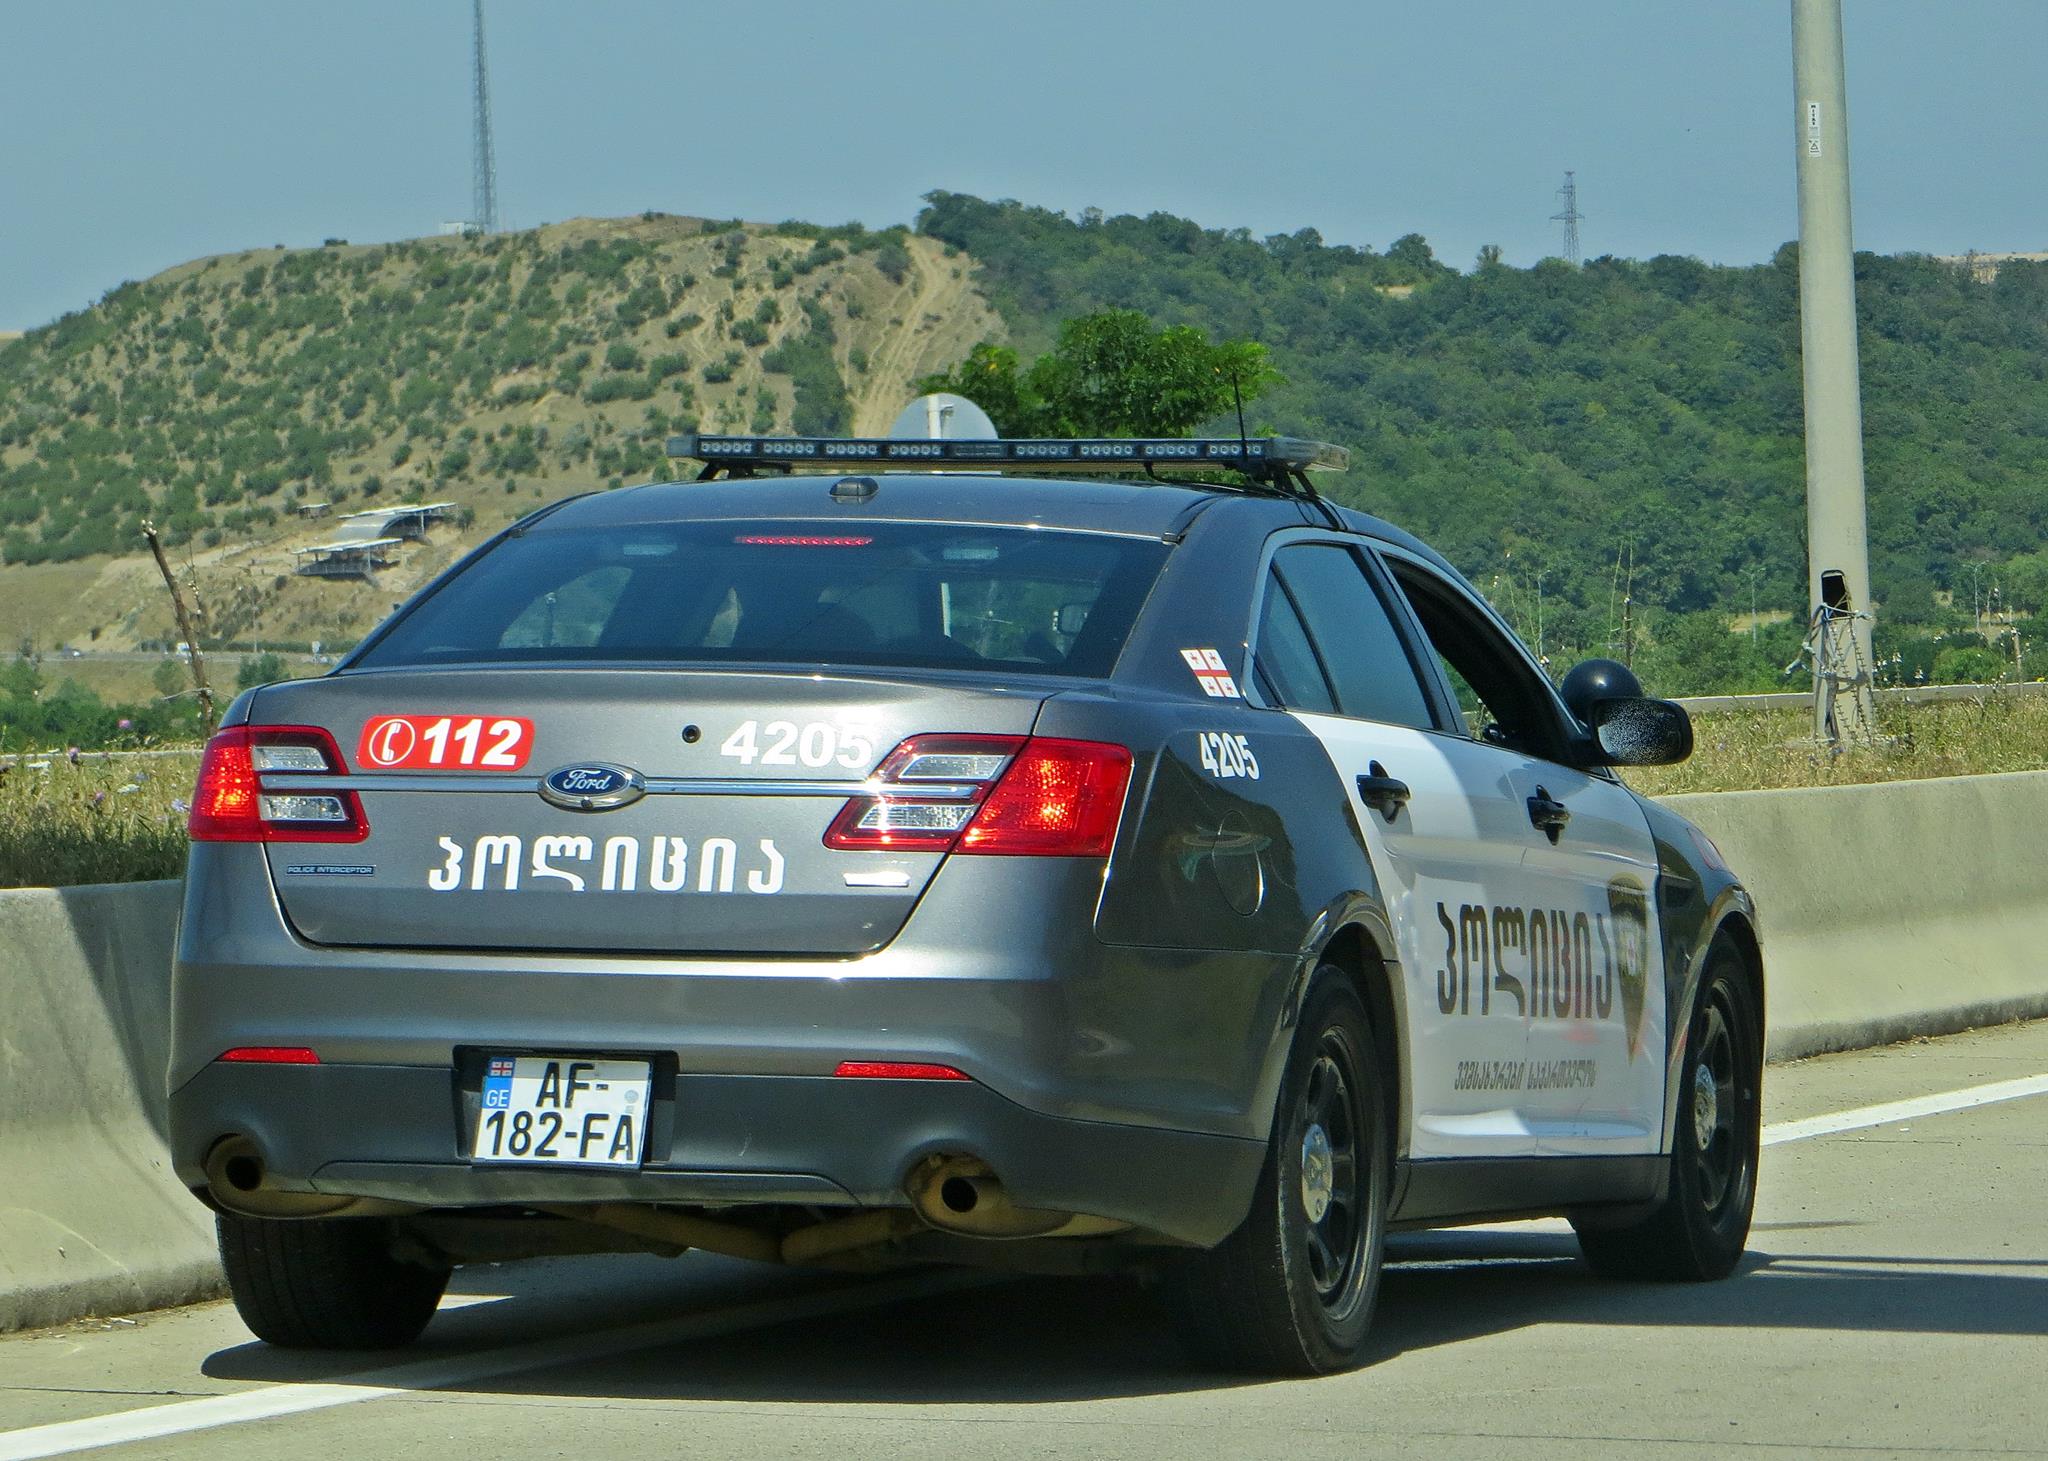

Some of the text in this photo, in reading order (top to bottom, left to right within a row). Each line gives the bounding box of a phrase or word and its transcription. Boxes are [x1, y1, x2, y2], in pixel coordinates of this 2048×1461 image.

[422, 718, 521, 766] 112
[720, 720, 874, 769] 4205
[1199, 732, 1260, 780] 4205
[562, 769, 613, 790] Ford
[287, 866, 373, 874] POLICE INTERCEPTOR
[428, 835, 786, 894] პოლიცია
[1437, 901, 1612, 1019] პოლიცია
[485, 1089, 509, 1108] GE
[485, 1110, 634, 1161] 182-FA
